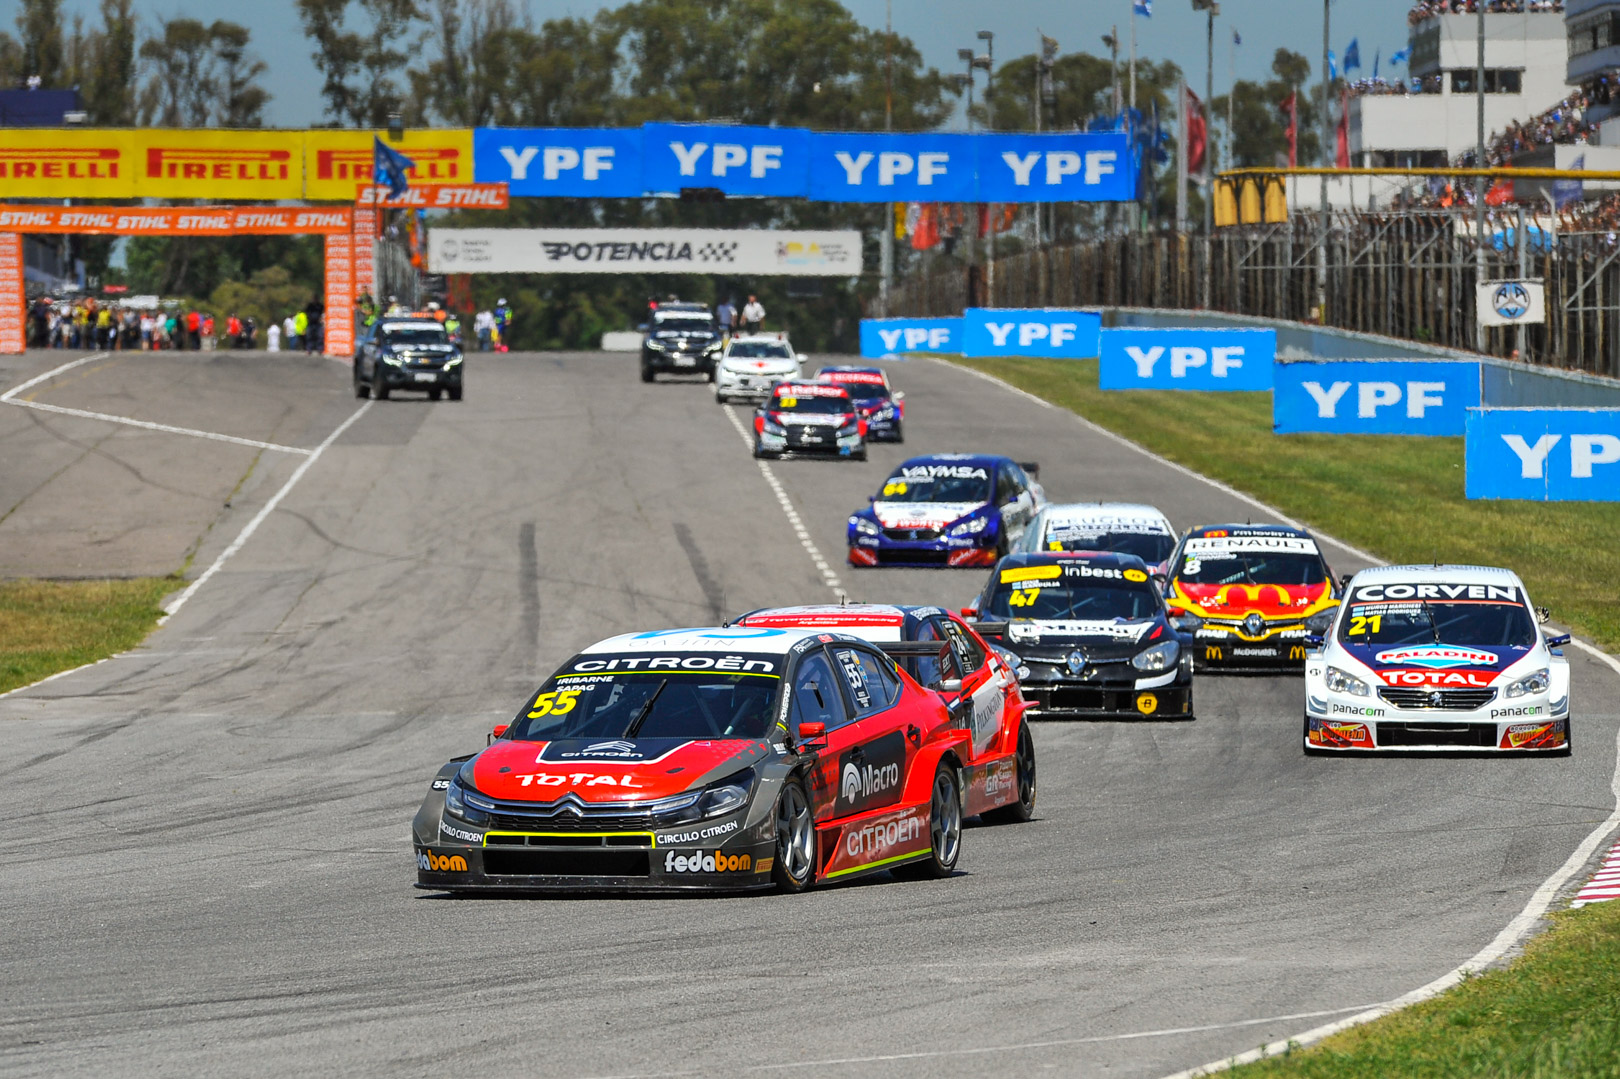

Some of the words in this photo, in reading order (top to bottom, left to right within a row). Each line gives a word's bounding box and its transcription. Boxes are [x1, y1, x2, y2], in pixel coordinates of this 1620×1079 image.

[0, 148, 120, 179] IRELLI
[147, 148, 291, 180] PIRELLI
[317, 148, 459, 180] PIRLLI
[500, 146, 615, 180] YPF
[669, 141, 783, 179] YPF
[834, 151, 949, 186] YPF
[1002, 150, 1117, 186] YPF
[359, 187, 427, 204] STHL
[434, 188, 504, 205] STIHL
[0, 211, 51, 226] STIHL
[58, 213, 113, 227] STIHL
[116, 215, 170, 229] STIHL
[177, 215, 231, 229] STIHL
[234, 213, 287, 227] STIHL
[295, 212, 348, 227] STIHL
[547, 242, 693, 261] POTENCIA
[878, 327, 950, 351] YPF
[985, 322, 1077, 347] YPF
[1124, 346, 1245, 378] YPF
[1302, 381, 1446, 419] YPF
[902, 465, 988, 480] VAYMSA
[1192, 539, 1310, 550] RENAULT
[1064, 565, 1123, 580] inbest
[1183, 560, 1201, 575] 8
[1009, 587, 1041, 607] 47
[1356, 585, 1517, 602] CORVEN
[1195, 629, 1229, 639] FRAM
[1280, 629, 1312, 639] FRAM
[1348, 615, 1382, 636] 21
[574, 656, 775, 673] CITROËN
[1381, 651, 1495, 662] PALADINI
[557, 675, 614, 685] IRIBARNE
[1382, 671, 1488, 686] TOTAL
[555, 685, 596, 693] SAPAG
[527, 690, 582, 719] 55
[1333, 703, 1385, 717] panacom
[1490, 706, 1543, 720] panacom
[433, 780, 450, 789] 55
[515, 772, 643, 789] TOTAL
[861, 762, 899, 798] Macro
[456, 829, 484, 843] CITROEN
[656, 831, 700, 844] CIRCULO
[700, 820, 738, 839] CITROEN
[846, 811, 920, 857] CITROËN
[664, 850, 752, 873] fedabom
